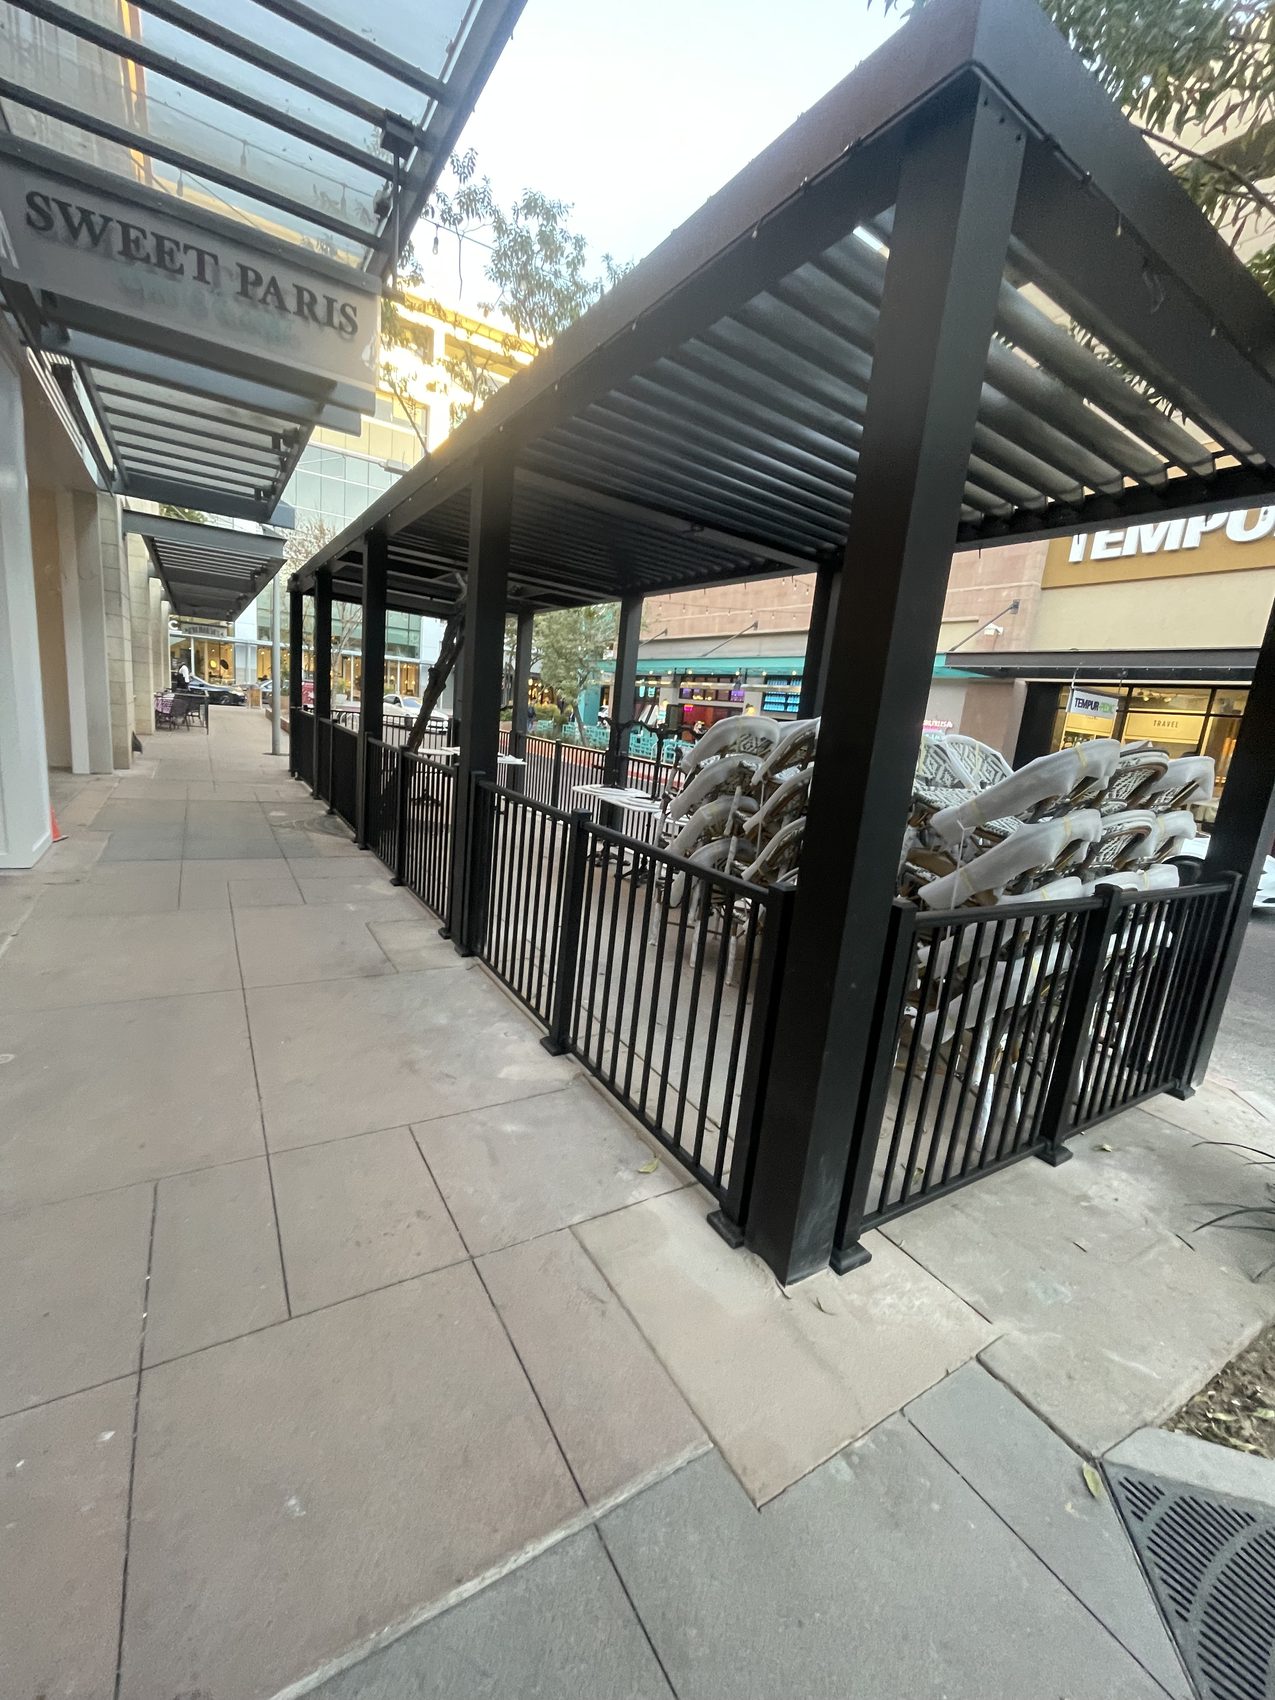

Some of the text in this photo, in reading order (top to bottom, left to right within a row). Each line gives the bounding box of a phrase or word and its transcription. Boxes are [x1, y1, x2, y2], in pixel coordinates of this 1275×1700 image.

[25, 190, 218, 284] SWEET
[234, 261, 359, 337] PARIS
[1068, 505, 1275, 563] TEMPU
[1153, 719, 1178, 728] TRAVEL
